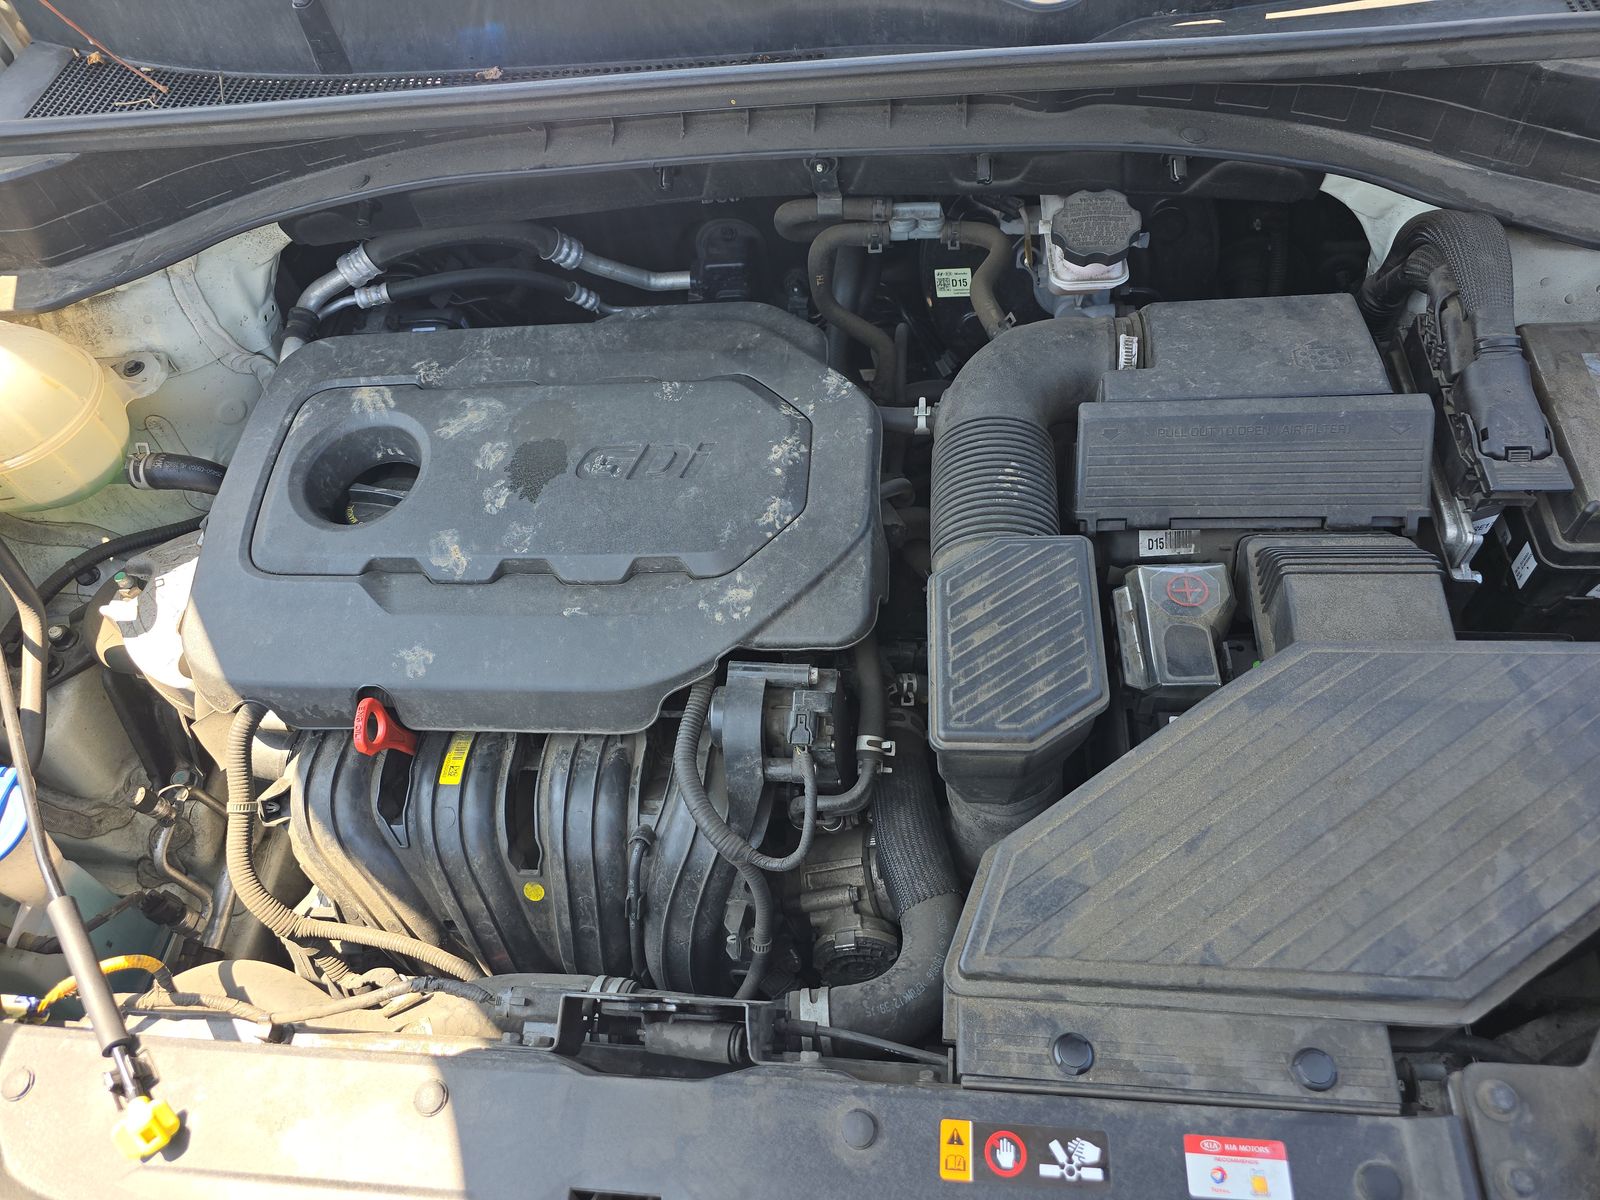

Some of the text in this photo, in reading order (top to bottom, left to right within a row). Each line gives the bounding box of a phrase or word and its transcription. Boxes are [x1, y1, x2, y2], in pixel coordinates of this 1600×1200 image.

[951, 278, 968, 288] D15
[1157, 427, 1188, 439] PULL
[1190, 426, 1216, 438] OUT
[1147, 537, 1165, 551] D15
[1224, 1143, 1238, 1151] KIA
[1239, 1145, 1270, 1154] MOTORS
